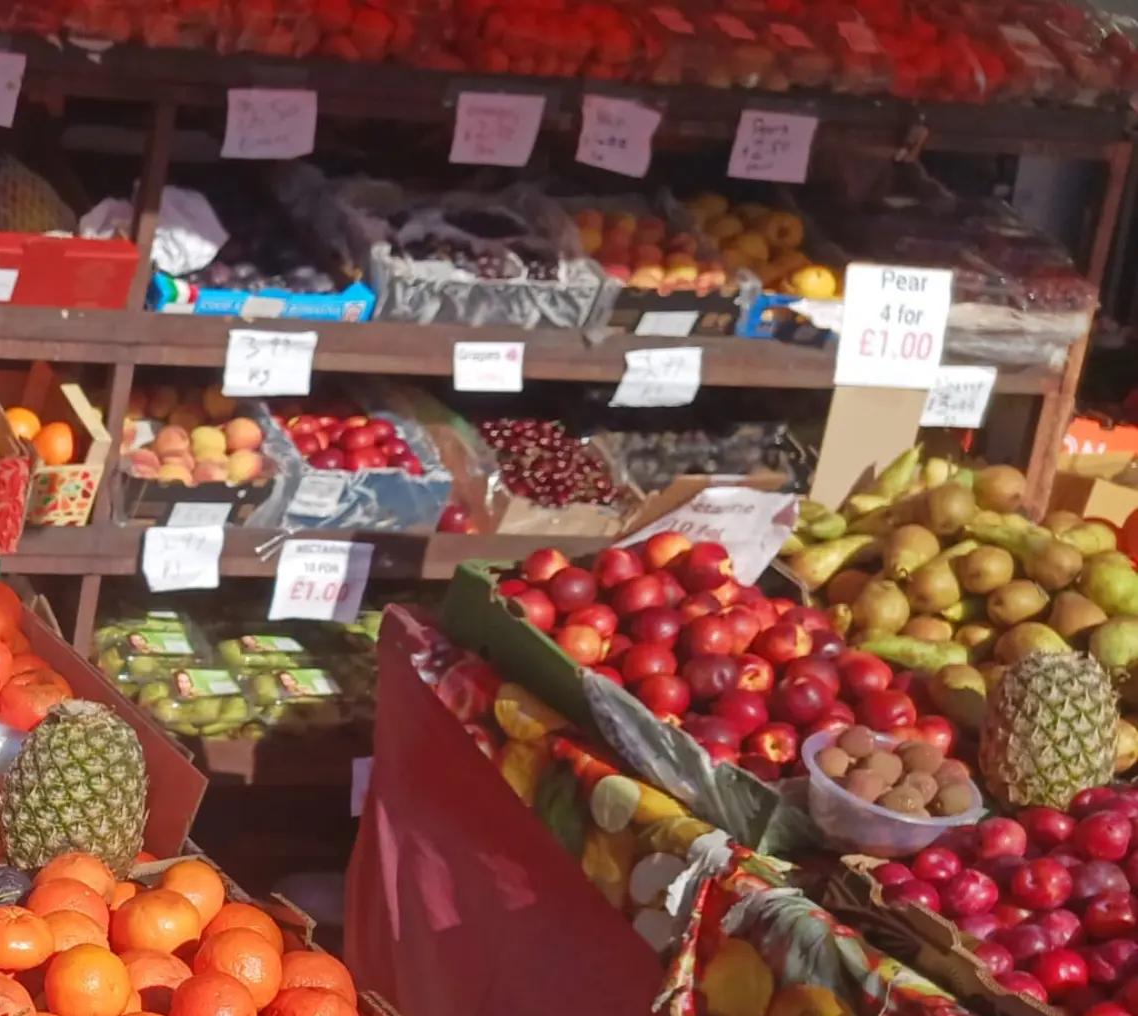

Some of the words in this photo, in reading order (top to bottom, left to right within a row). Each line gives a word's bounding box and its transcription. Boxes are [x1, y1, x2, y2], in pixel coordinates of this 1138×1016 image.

[881, 269, 928, 292] Pear
[879, 303, 891, 323] 4
[897, 303, 924, 326] for
[859, 327, 934, 361] £1.00
[318, 562, 339, 574] FOR
[289, 580, 350, 602] £1.00
